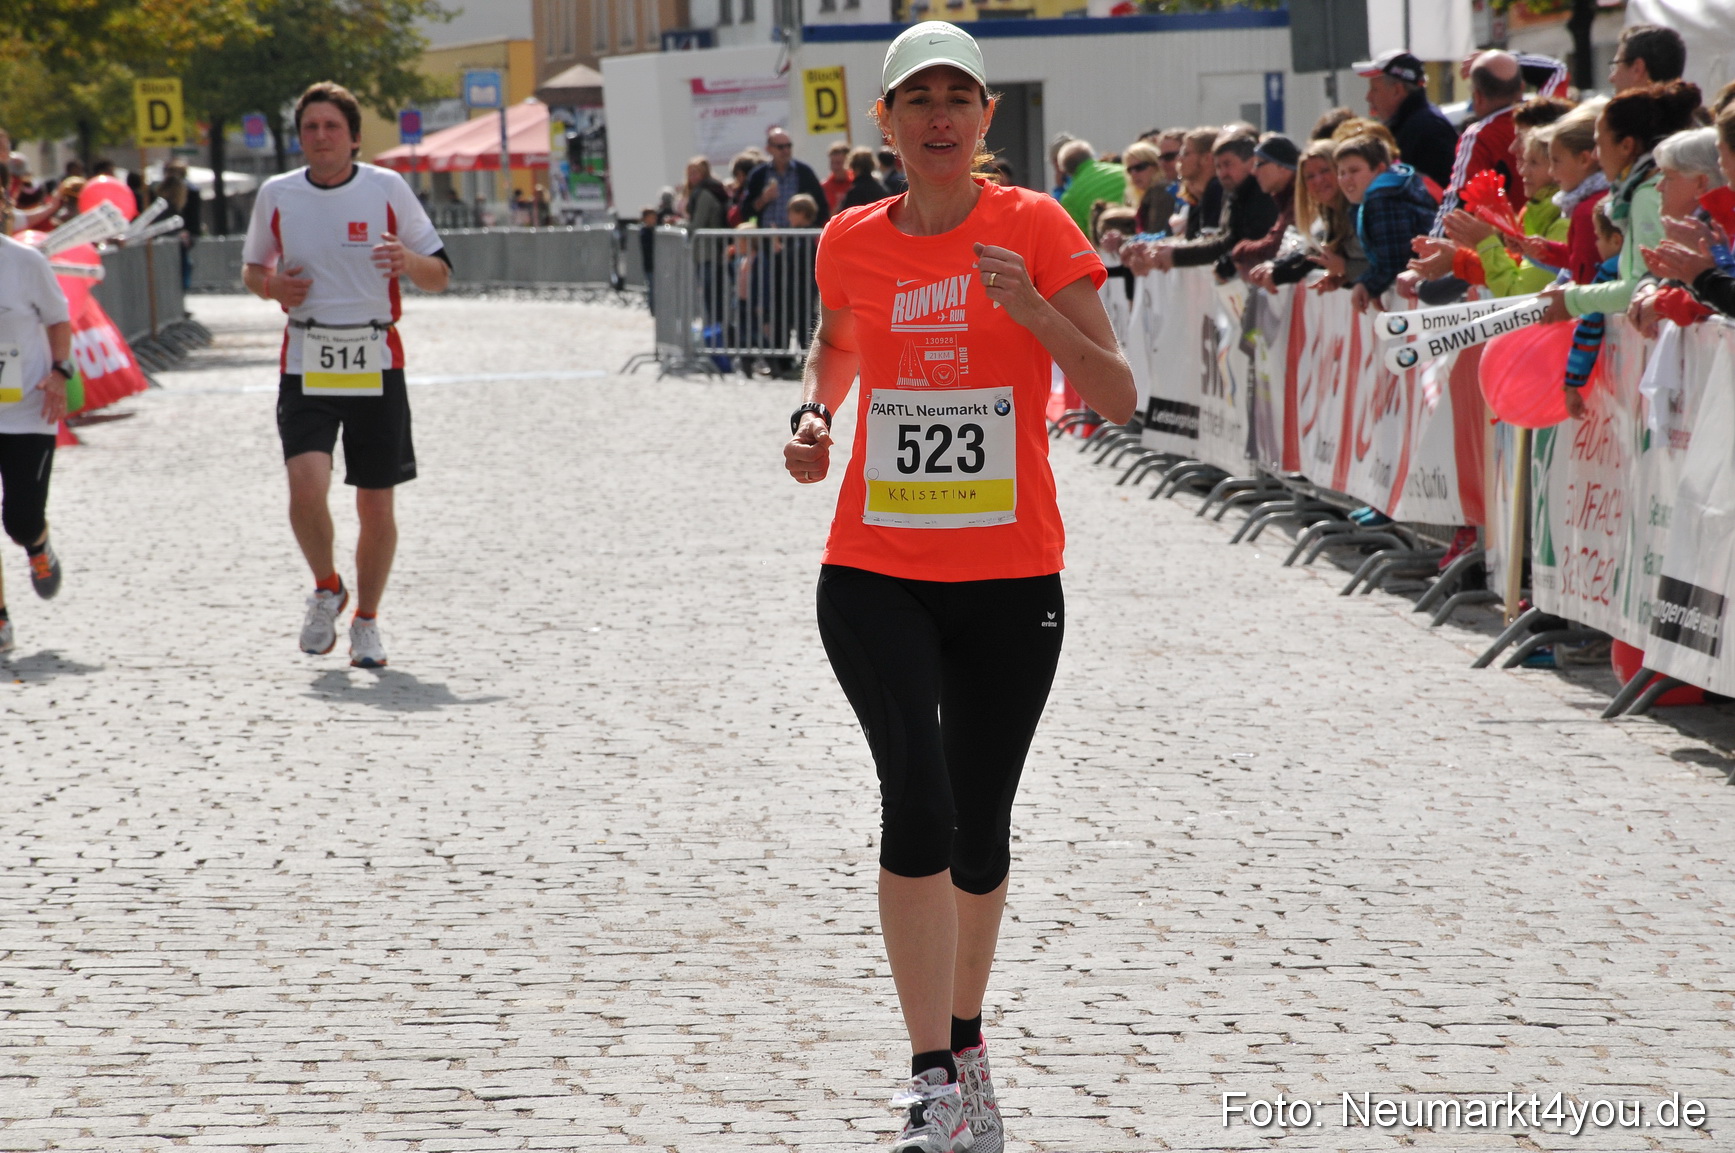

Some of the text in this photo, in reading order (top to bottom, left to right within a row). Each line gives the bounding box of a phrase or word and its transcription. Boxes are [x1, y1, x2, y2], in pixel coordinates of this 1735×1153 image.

[816, 87, 837, 119] D
[149, 99, 171, 131] D
[891, 273, 972, 324] RUNWAY
[949, 309, 966, 322] RUN
[924, 336, 955, 345] 130928
[1428, 326, 1476, 357] BMW
[320, 345, 367, 370] 514
[929, 351, 951, 359] 21 KM
[958, 346, 968, 363] BUD
[870, 402, 989, 417] PARTL Neumarkt
[896, 423, 986, 475] 523
[888, 488, 977, 502] KRISZTINA
